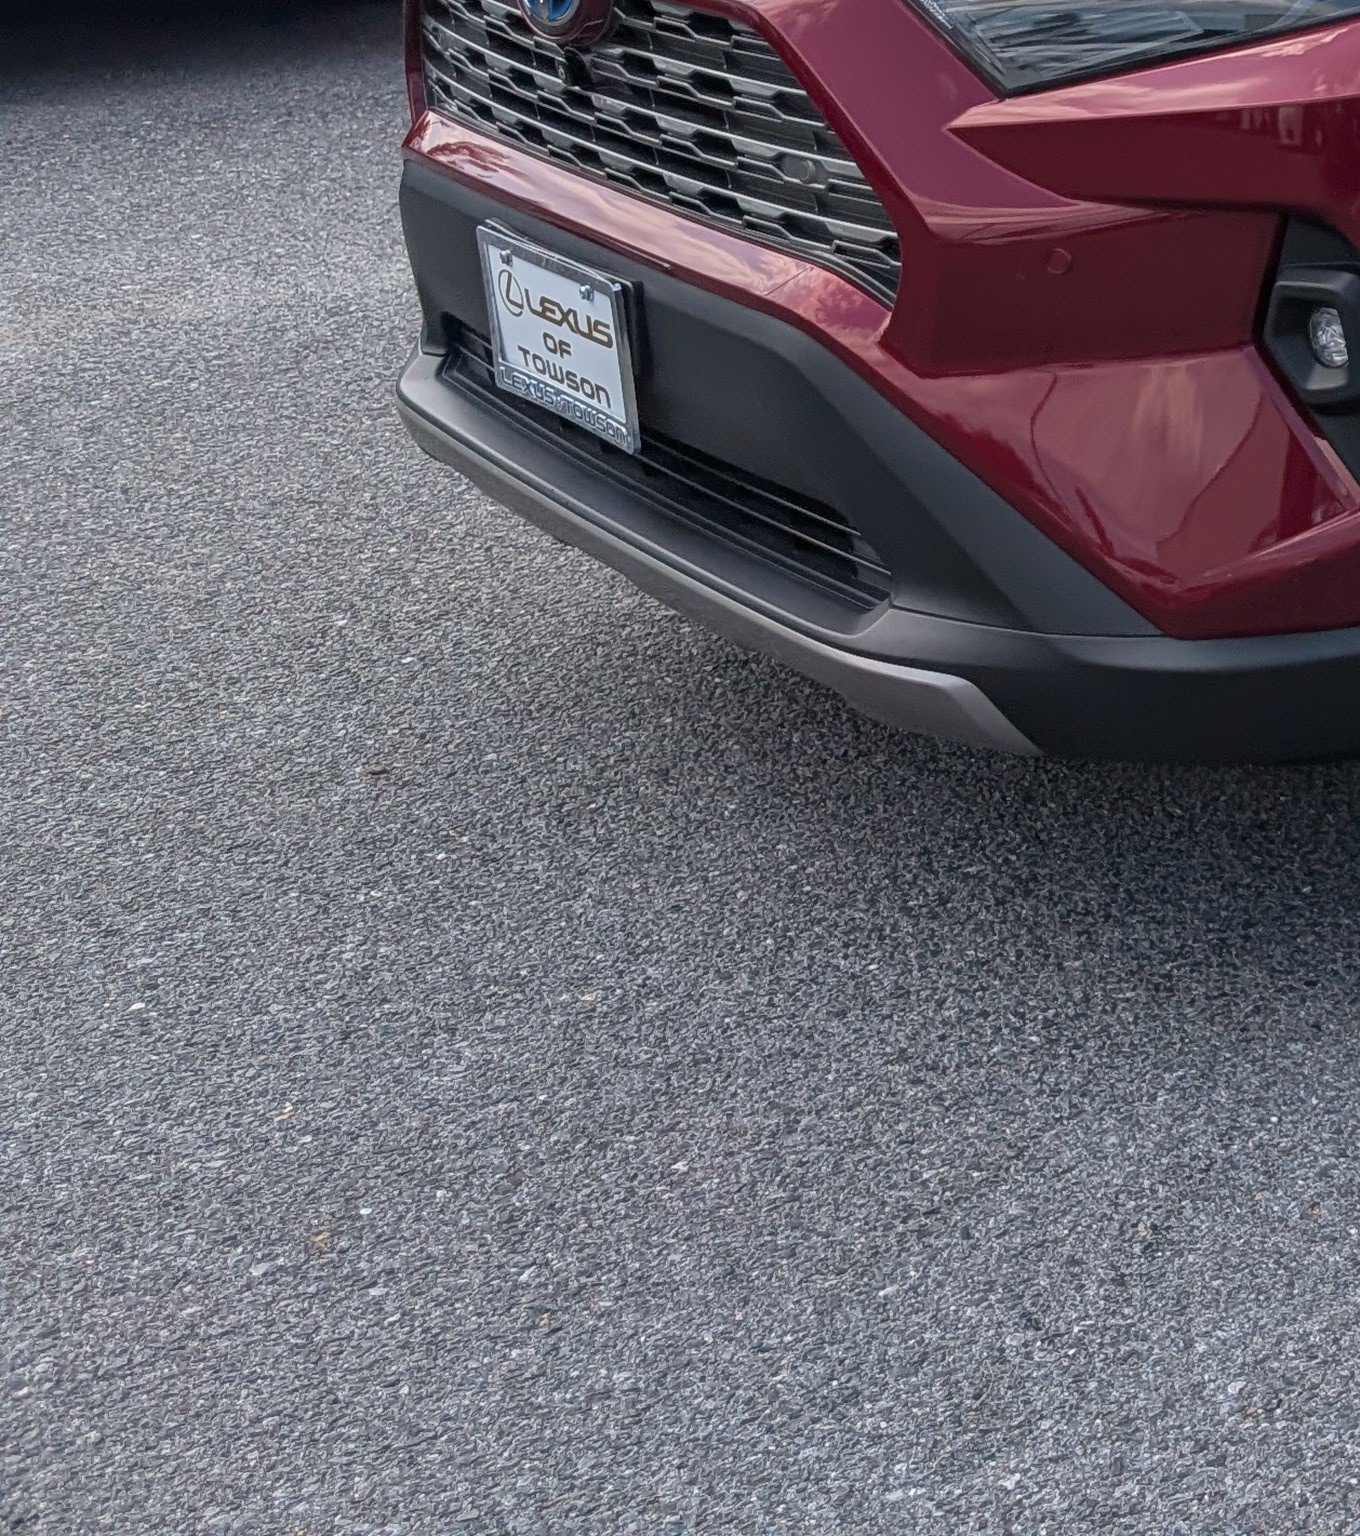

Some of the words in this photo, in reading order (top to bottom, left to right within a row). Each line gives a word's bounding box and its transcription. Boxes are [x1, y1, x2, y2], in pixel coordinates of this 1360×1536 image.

[524, 288, 614, 349] LEXUS
[542, 331, 572, 358] OF
[500, 365, 556, 407] LEXUS
[559, 394, 630, 447] TOWSON
[517, 345, 612, 409] TOWSON
